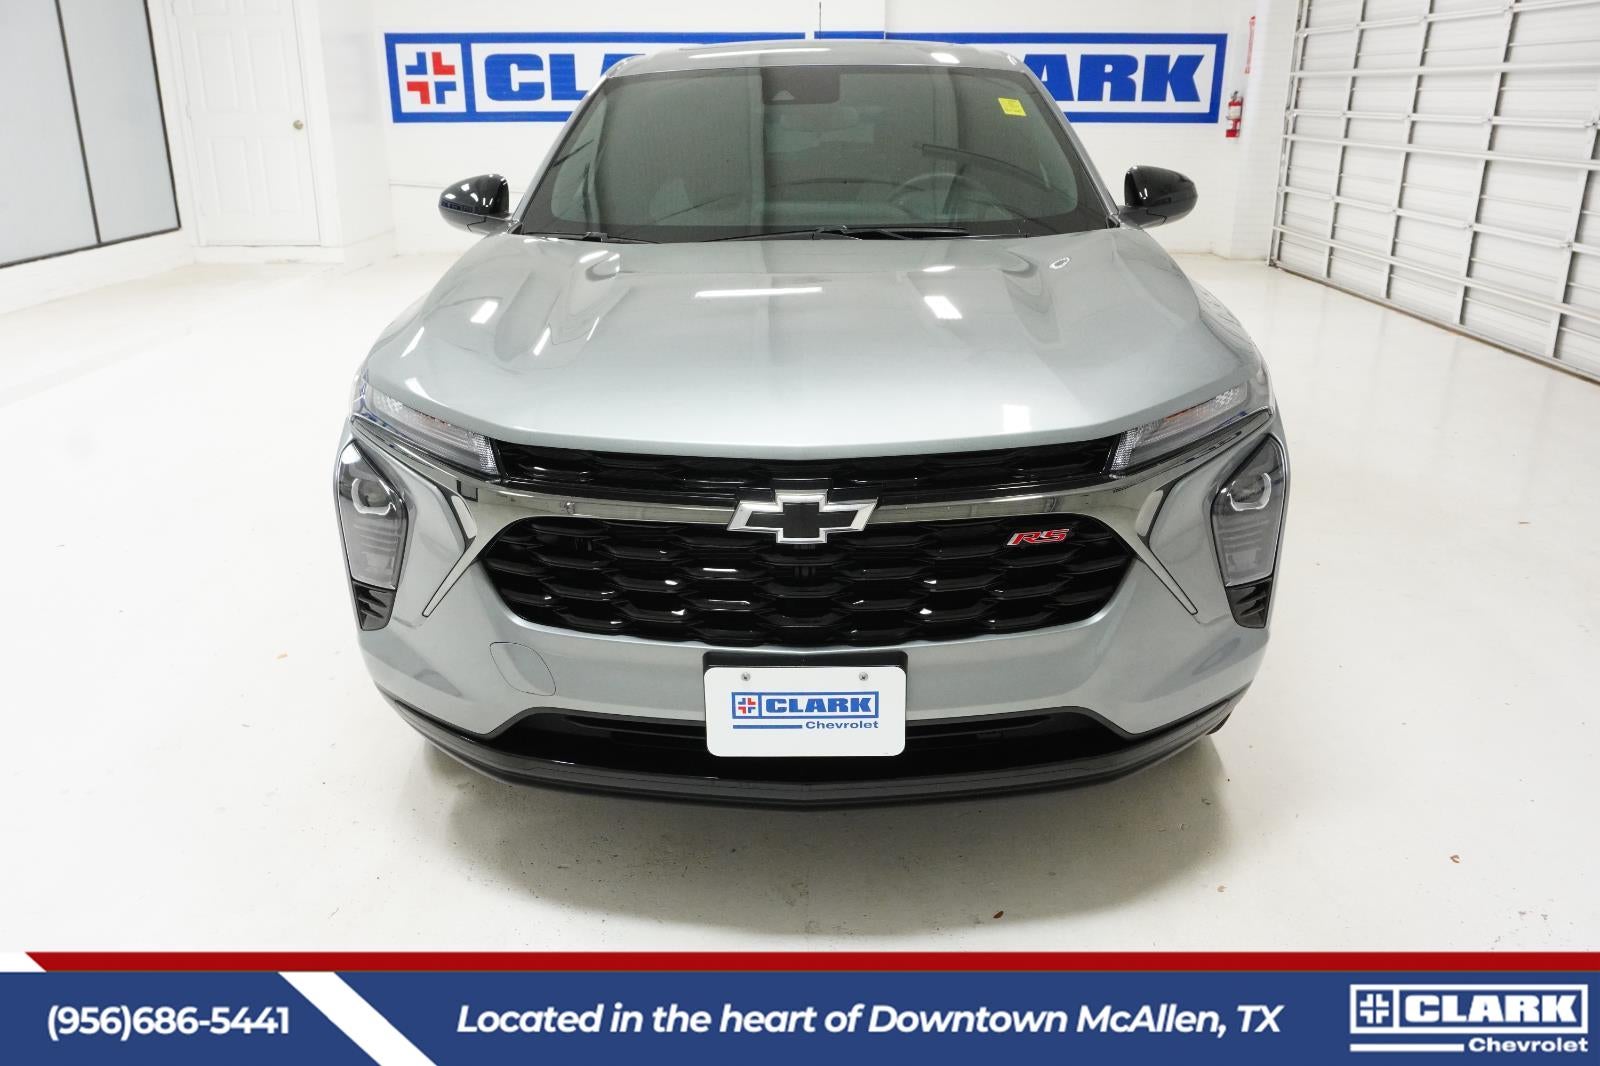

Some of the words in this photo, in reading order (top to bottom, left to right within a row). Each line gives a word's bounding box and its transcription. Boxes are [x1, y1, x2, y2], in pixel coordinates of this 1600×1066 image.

[1007, 528, 1070, 546] RS
[764, 697, 873, 714] CLARK
[805, 718, 881, 731] Chevrolet
